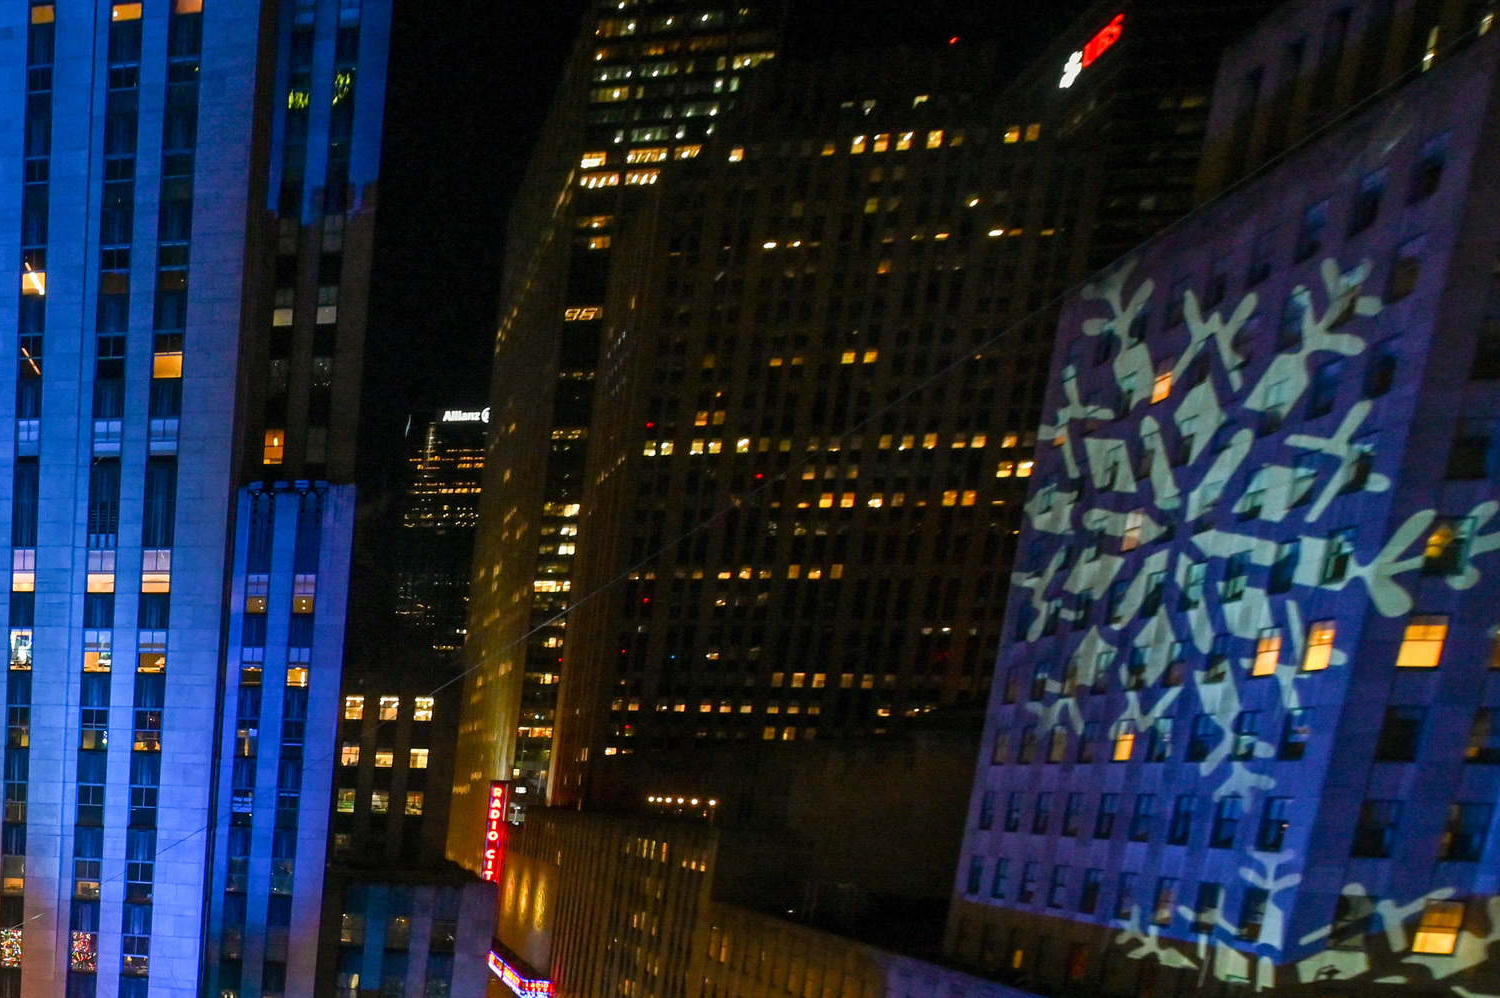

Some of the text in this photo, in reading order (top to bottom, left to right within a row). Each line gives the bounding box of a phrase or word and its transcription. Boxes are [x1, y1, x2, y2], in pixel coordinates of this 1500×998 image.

[442, 410, 480, 421] Allianz
[485, 787, 502, 880] RADIO CIT
